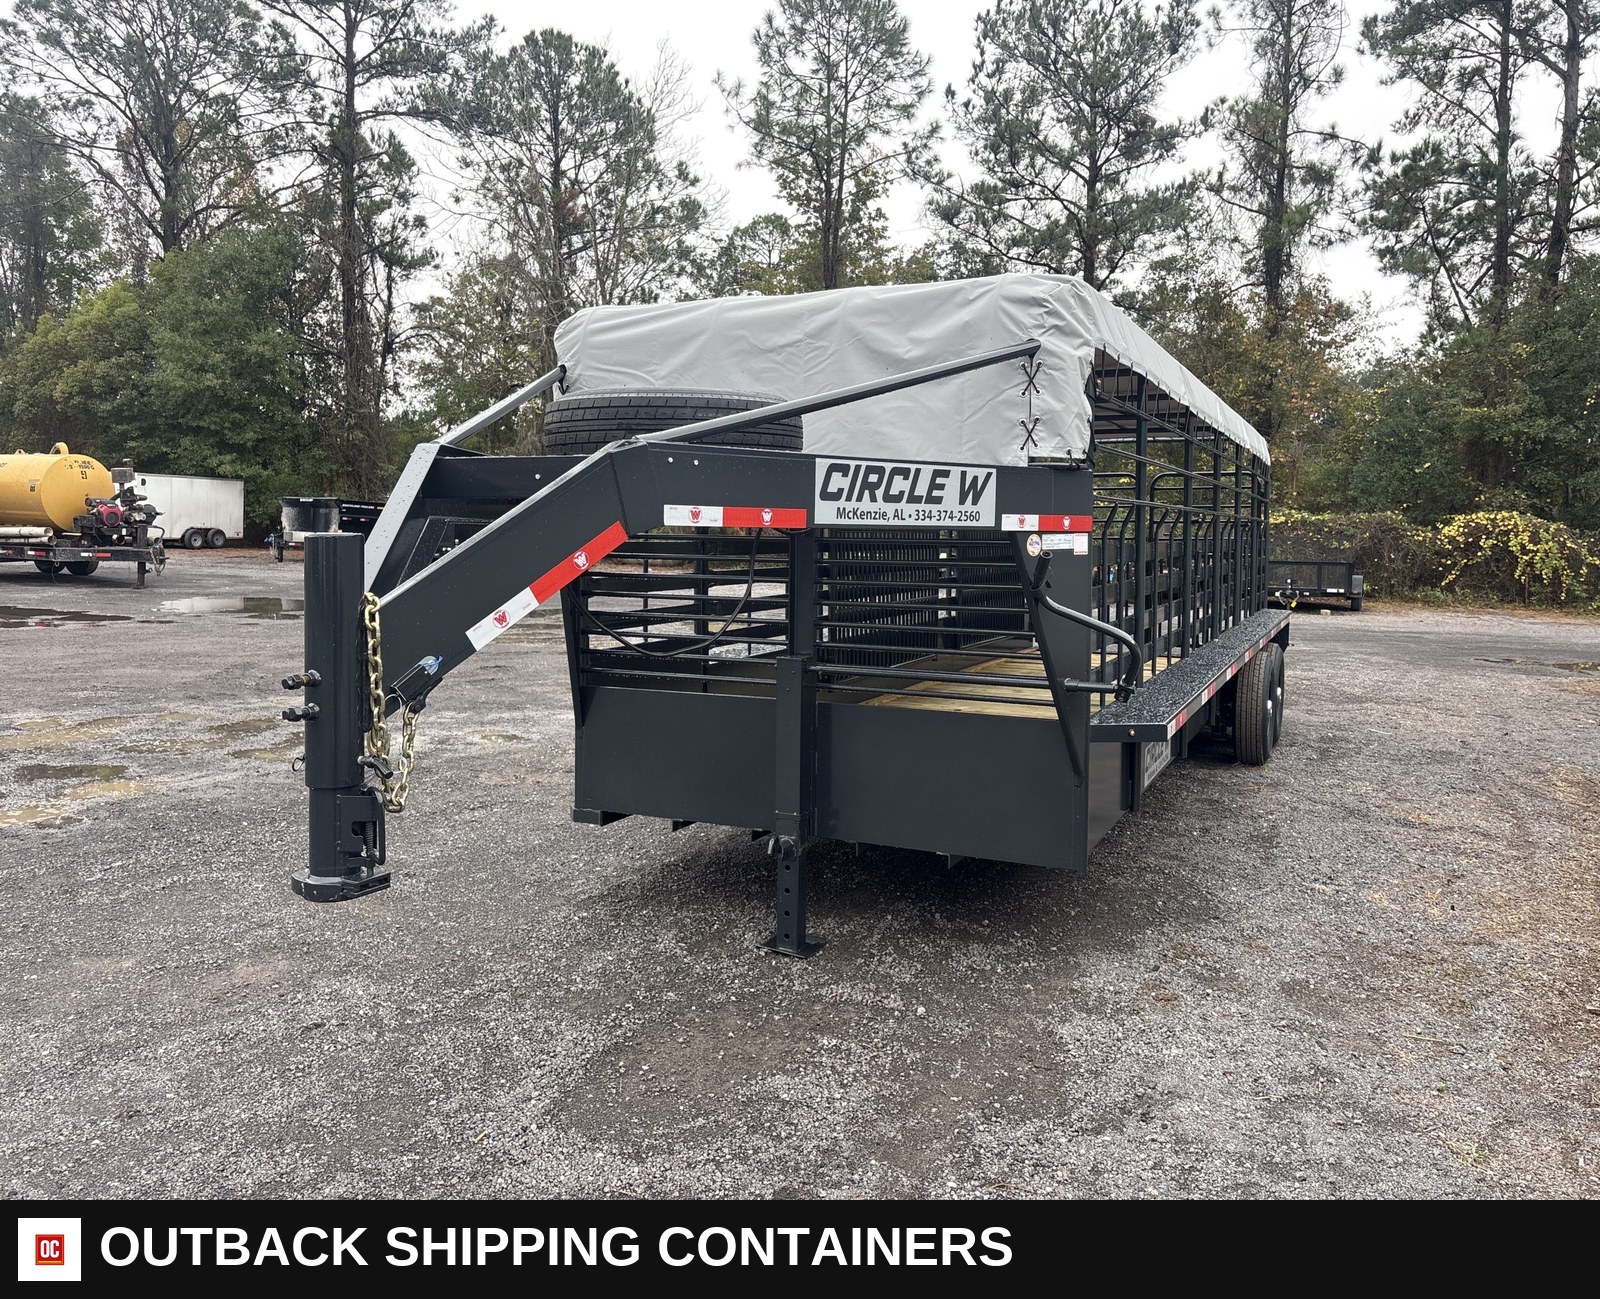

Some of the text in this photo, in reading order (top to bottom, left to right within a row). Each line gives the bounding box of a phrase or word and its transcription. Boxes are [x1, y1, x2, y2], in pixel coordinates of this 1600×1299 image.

[819, 462, 993, 506] CIRCLE W
[836, 506, 981, 522] McKenzie, AL 334-374-2560
